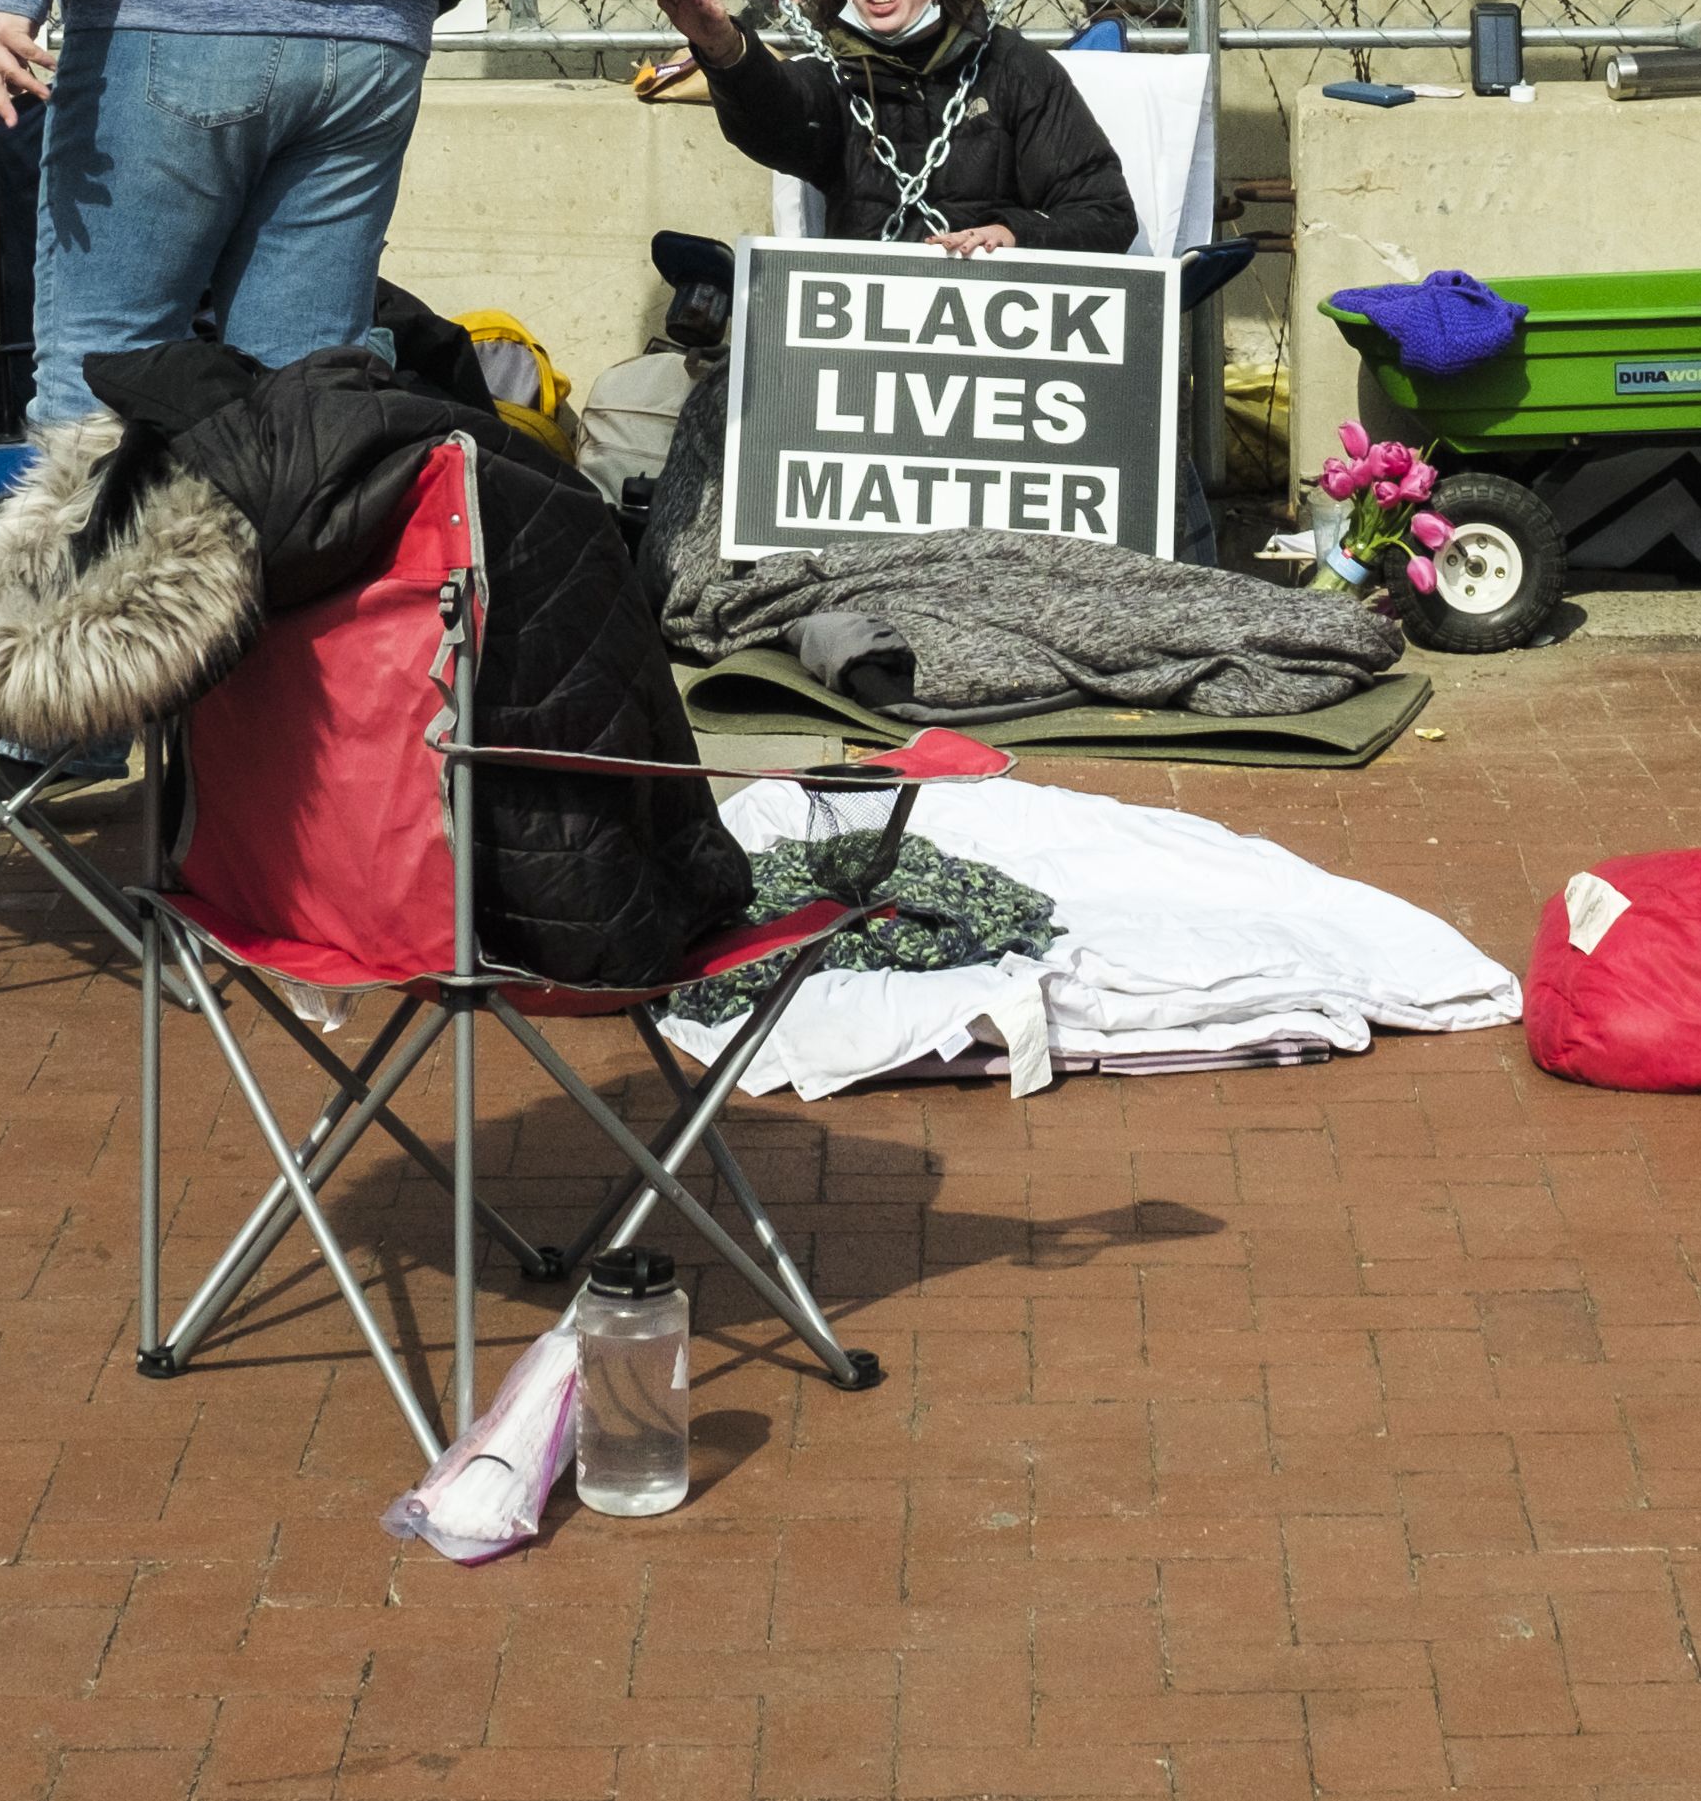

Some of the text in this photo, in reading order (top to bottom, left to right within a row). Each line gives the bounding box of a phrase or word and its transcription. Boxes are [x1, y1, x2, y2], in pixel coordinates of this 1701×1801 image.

[798, 279, 1111, 356] BLACK
[815, 368, 1087, 445] LIVES
[784, 459, 1108, 535] MATTER
